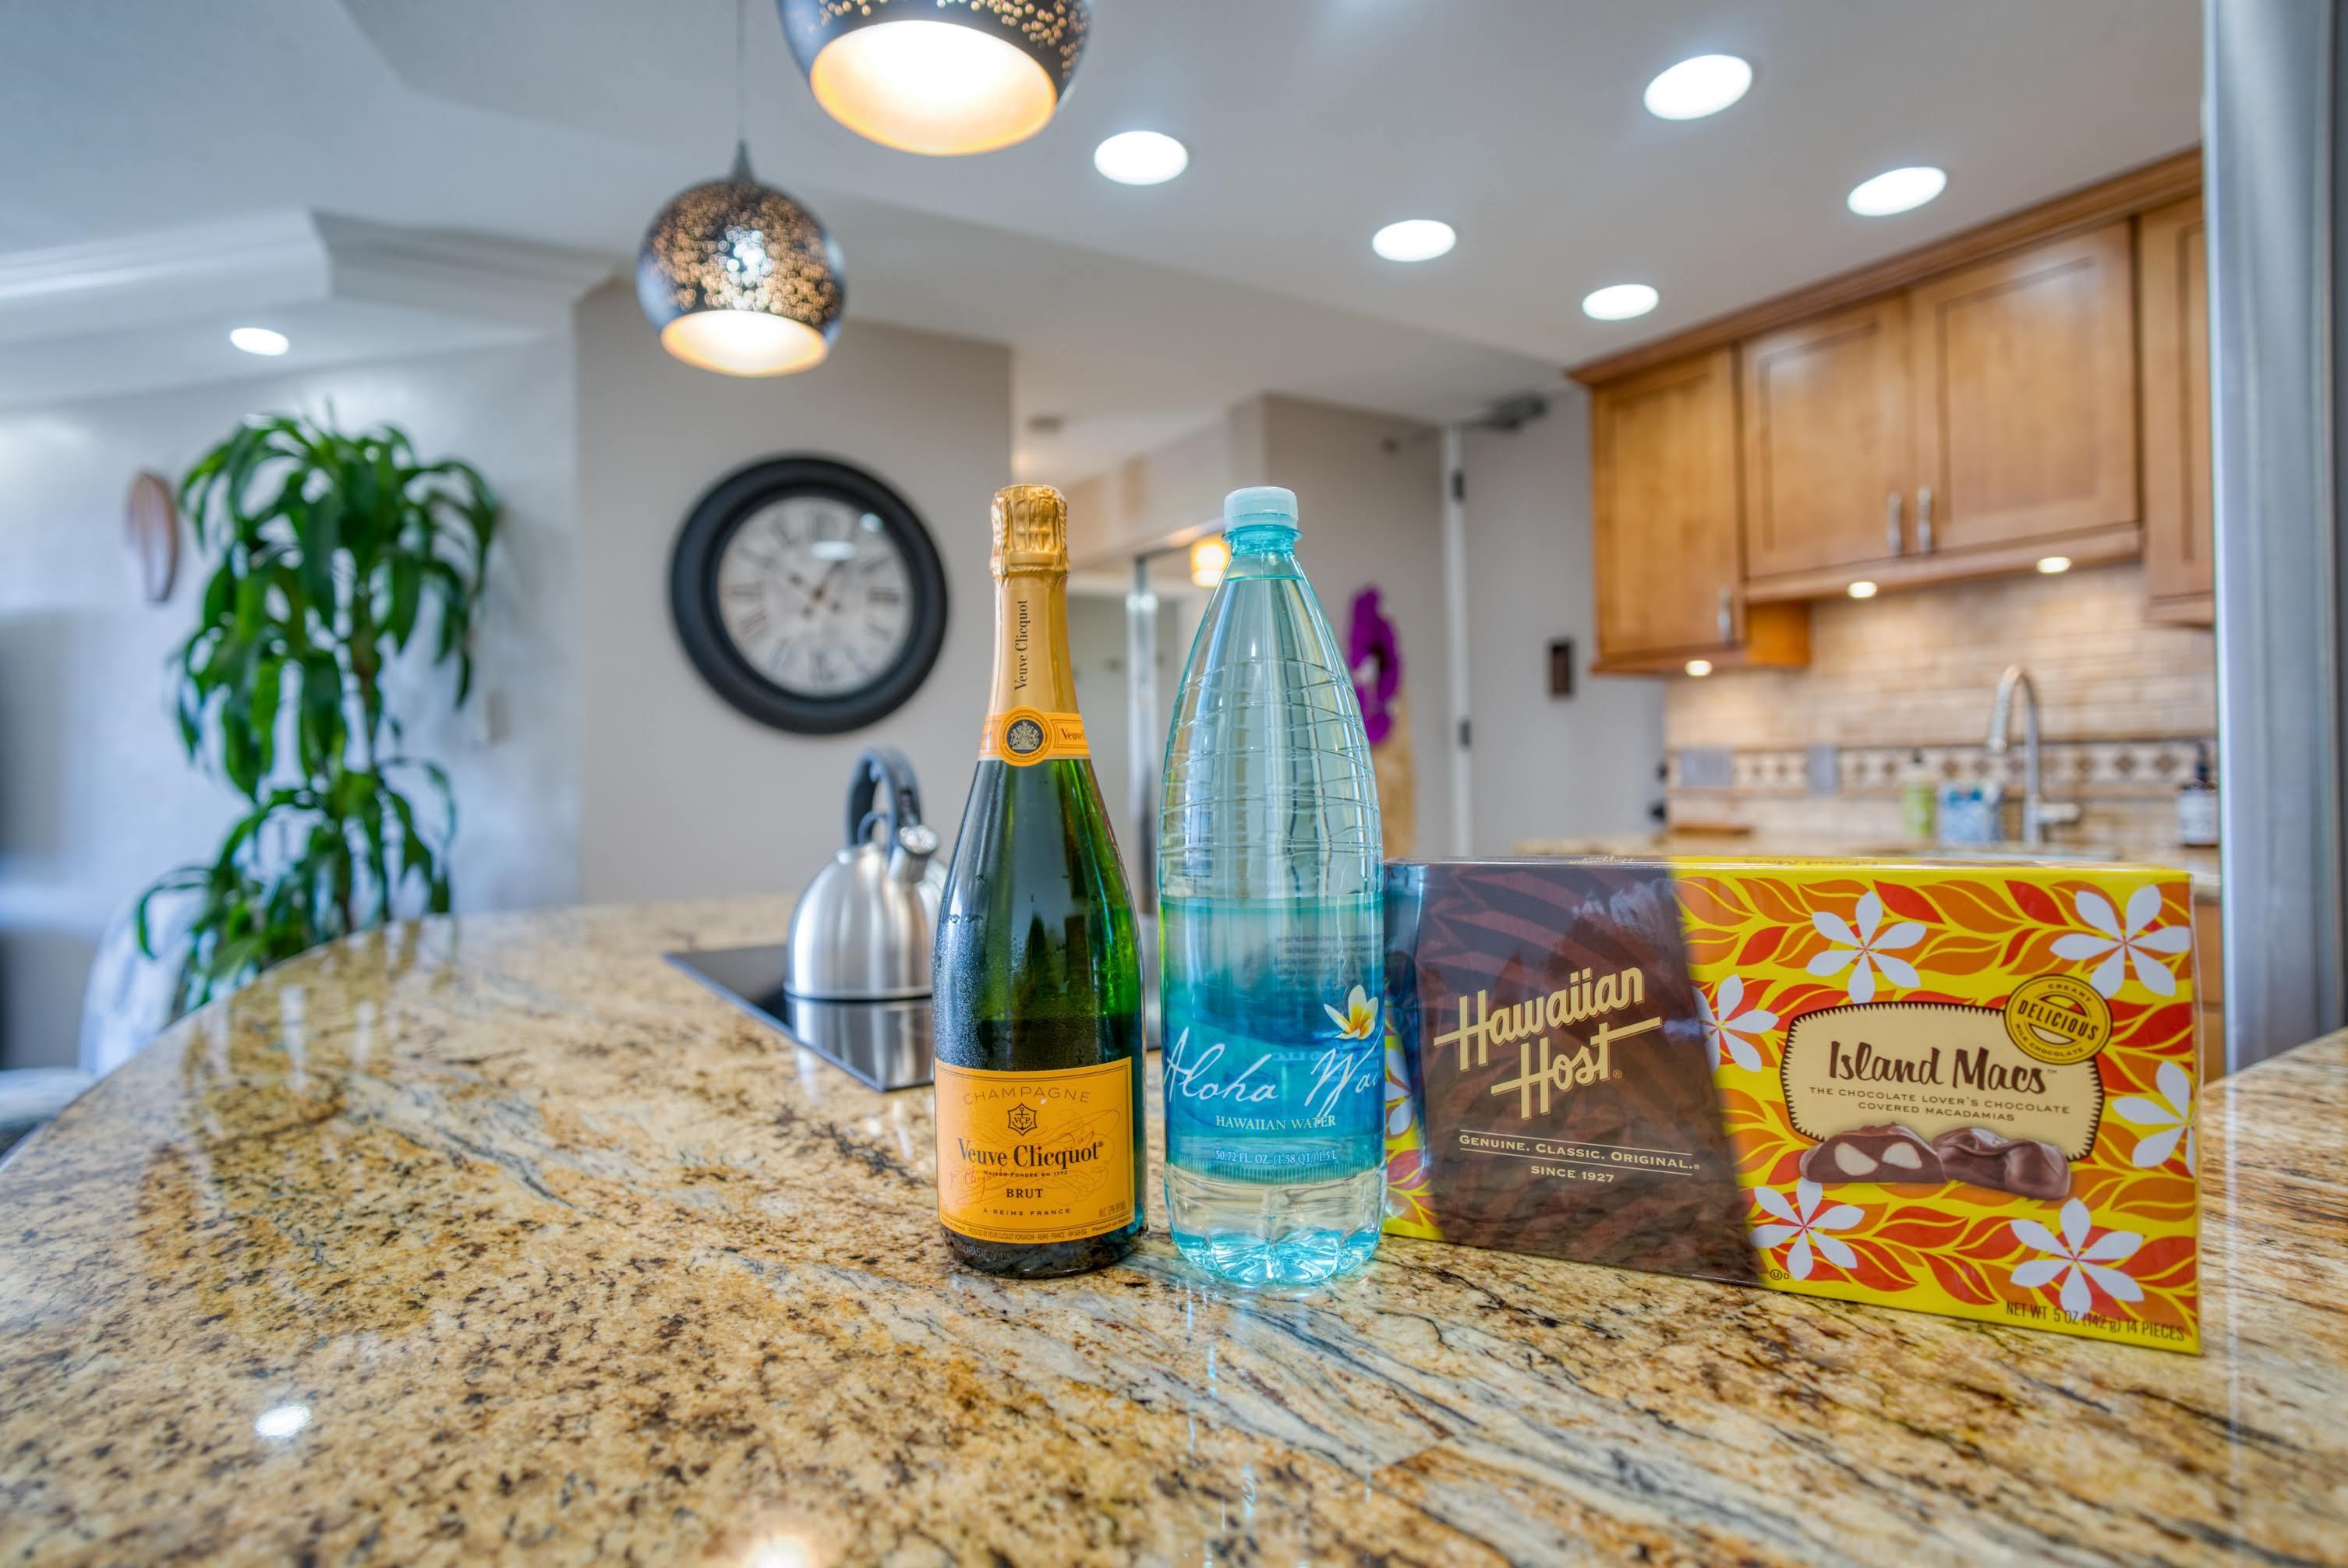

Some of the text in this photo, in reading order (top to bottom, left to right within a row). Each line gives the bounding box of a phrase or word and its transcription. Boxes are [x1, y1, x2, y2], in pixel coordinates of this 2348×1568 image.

[1014, 600, 1031, 691] Veuve Clicquot
[2047, 984, 2093, 1002] CREAMY
[1433, 966, 1645, 1072] Hawaiian
[2017, 999, 2099, 1041] DELICIOUS
[2015, 1023, 2085, 1057] MILK CHOCOLATE
[1162, 1026, 1279, 1103] Aloha
[1829, 1040, 1945, 1085] Island
[964, 1086, 1091, 1105] CHAMPAGNE
[1809, 1086, 2070, 1115] THE CHOCOLATE LOVER'S CHOCOLATE
[1215, 1115, 1336, 1130] HAWAIIAN WATER
[1858, 1102, 2016, 1122] COVERED MACADAMIAS
[957, 1137, 1008, 1167] Veuve
[1215, 1150, 1237, 1162] 50.72
[1239, 1153, 1253, 1164] FL.
[1254, 1153, 1271, 1164] OZ.
[1273, 1153, 1296, 1167] (1.58
[1298, 1153, 1317, 1166] QT.)
[1459, 1135, 1530, 1152] GENUINE.
[1535, 1143, 1606, 1160] CLASSIC.
[1530, 1165, 1615, 1183] SINCE 1927
[1006, 1188, 1044, 1199] BRUT
[2006, 1301, 2025, 1317] NET
[2030, 1304, 2047, 1319] WT
[2053, 1308, 2060, 1323] 5
[2063, 1309, 2079, 1325] OZ
[2127, 1319, 2138, 1334] 14
[2141, 1321, 2185, 1341] PIECES
